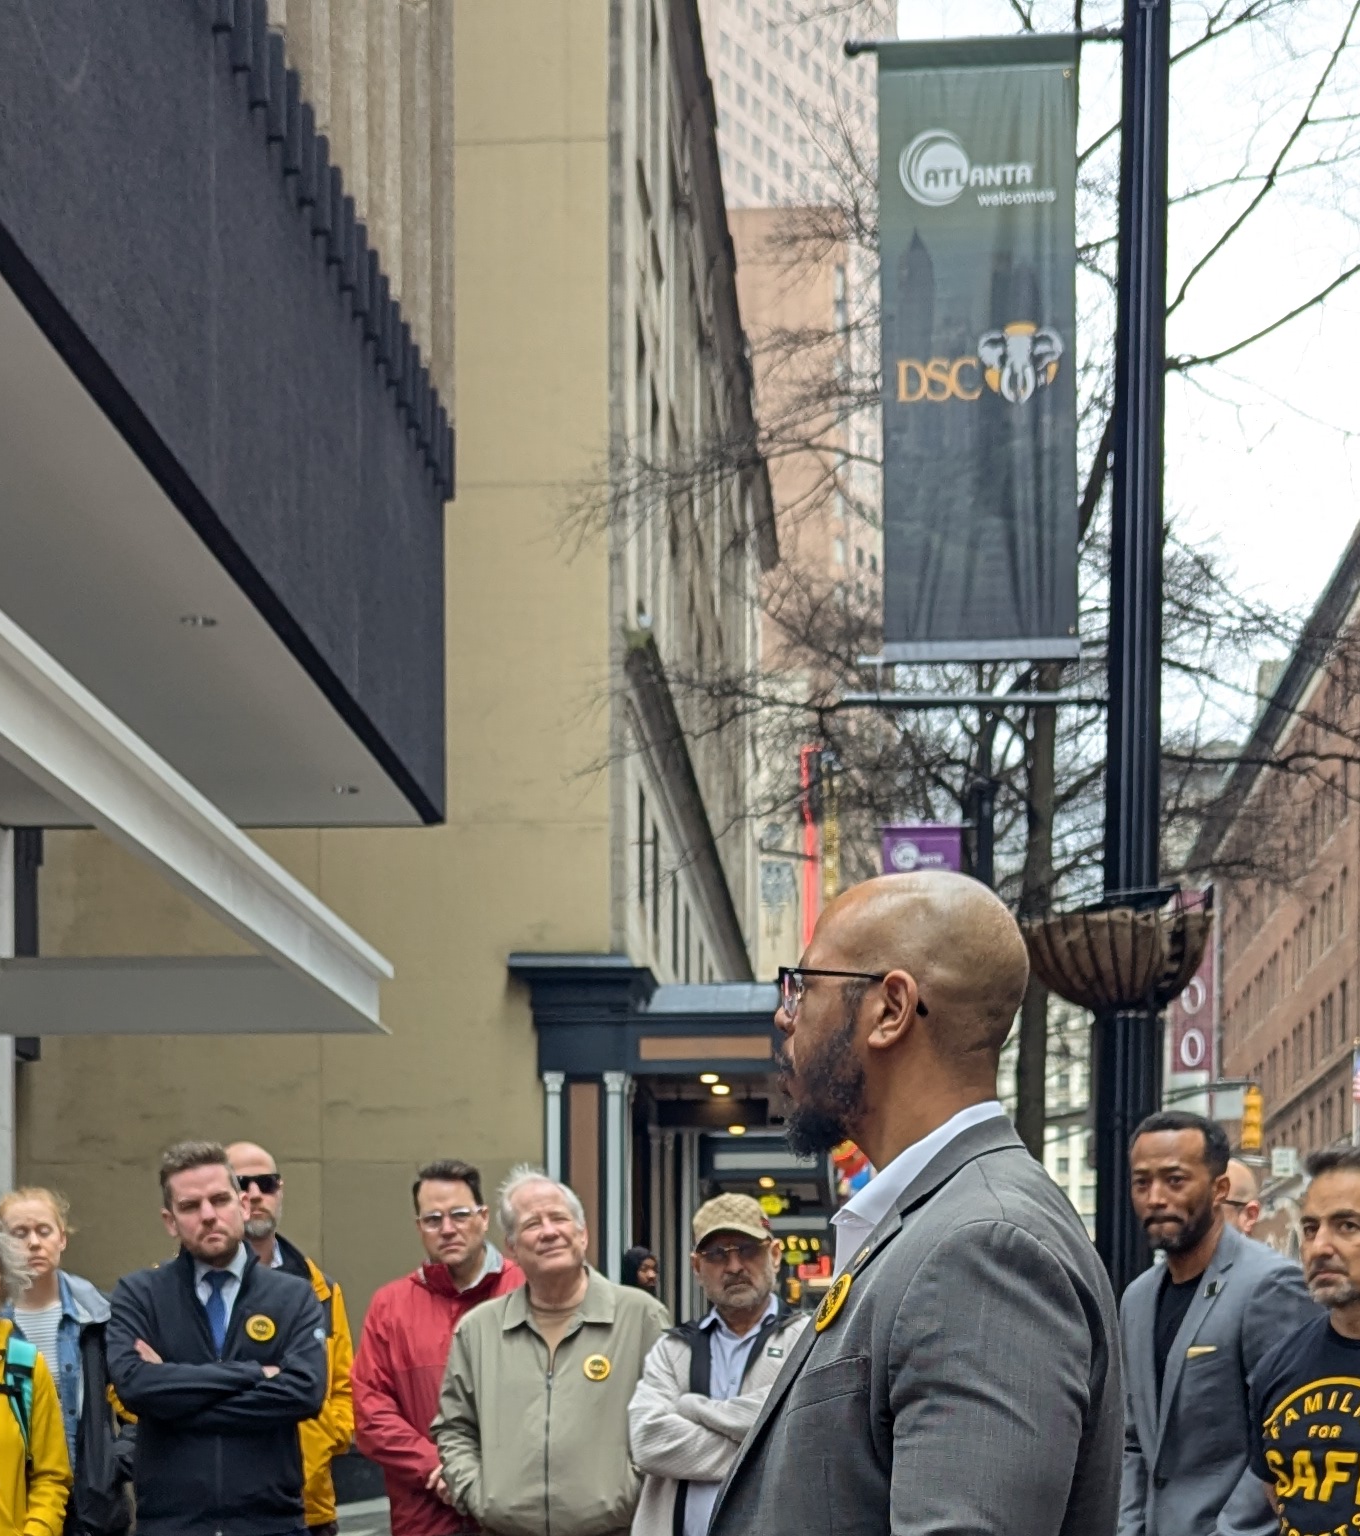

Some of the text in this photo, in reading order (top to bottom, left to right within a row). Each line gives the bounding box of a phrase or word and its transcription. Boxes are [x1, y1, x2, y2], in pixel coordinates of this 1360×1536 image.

[924, 164, 1034, 188] ATLANTA
[977, 189, 1057, 207] welcomes
[897, 356, 983, 402] DSC
[1308, 1424, 1343, 1439] FOR
